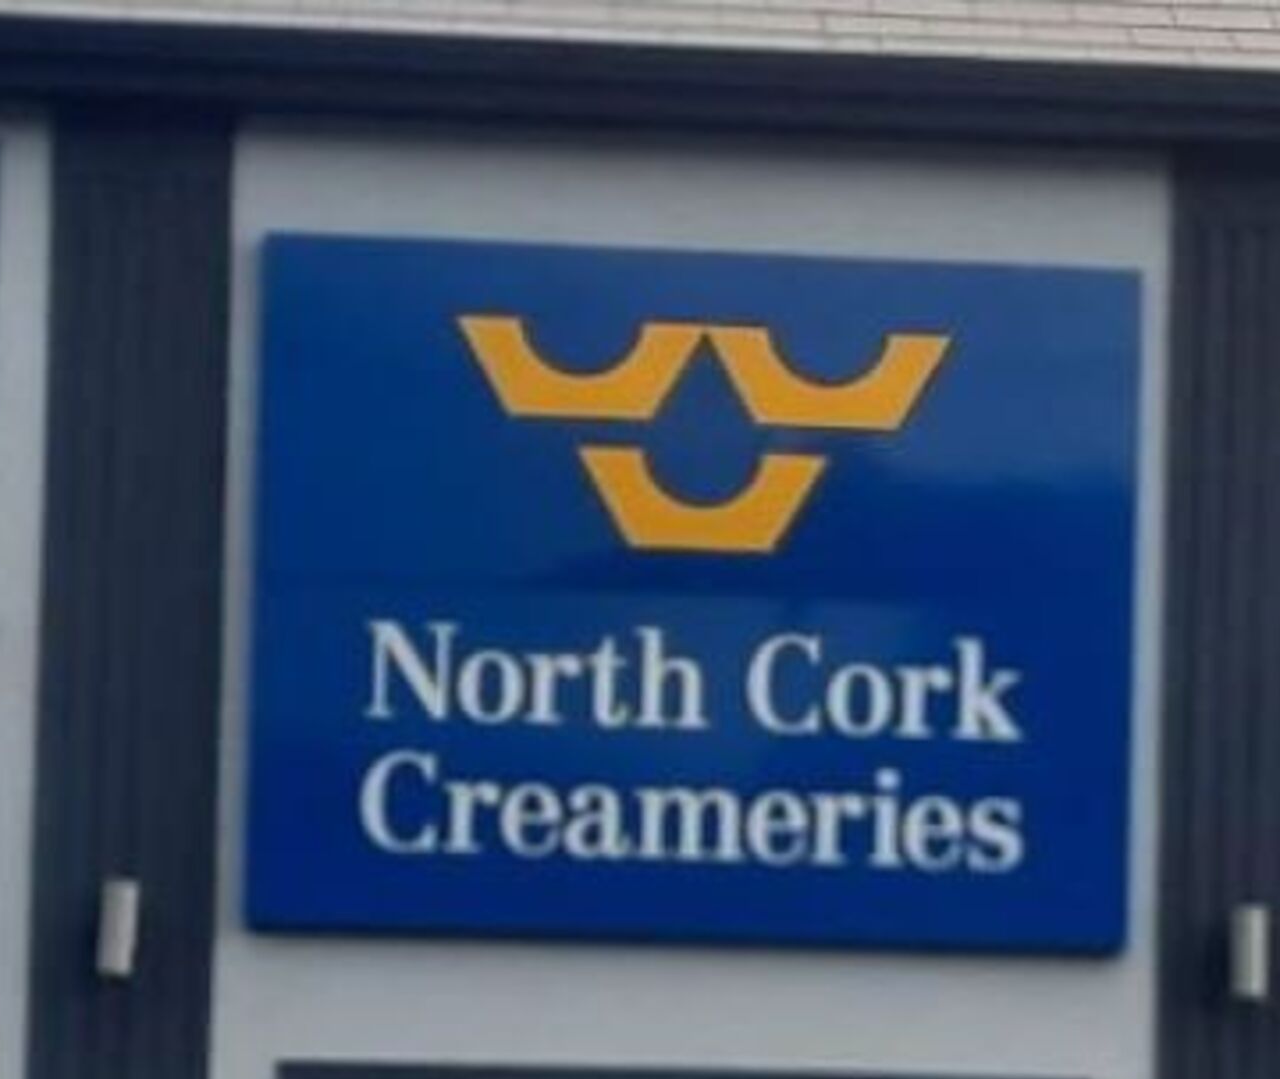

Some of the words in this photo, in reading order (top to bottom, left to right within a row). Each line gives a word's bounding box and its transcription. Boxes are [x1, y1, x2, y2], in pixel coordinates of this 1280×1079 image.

[364, 619, 708, 734] North
[744, 632, 1025, 744] Cork
[358, 749, 1026, 875] Creameries
